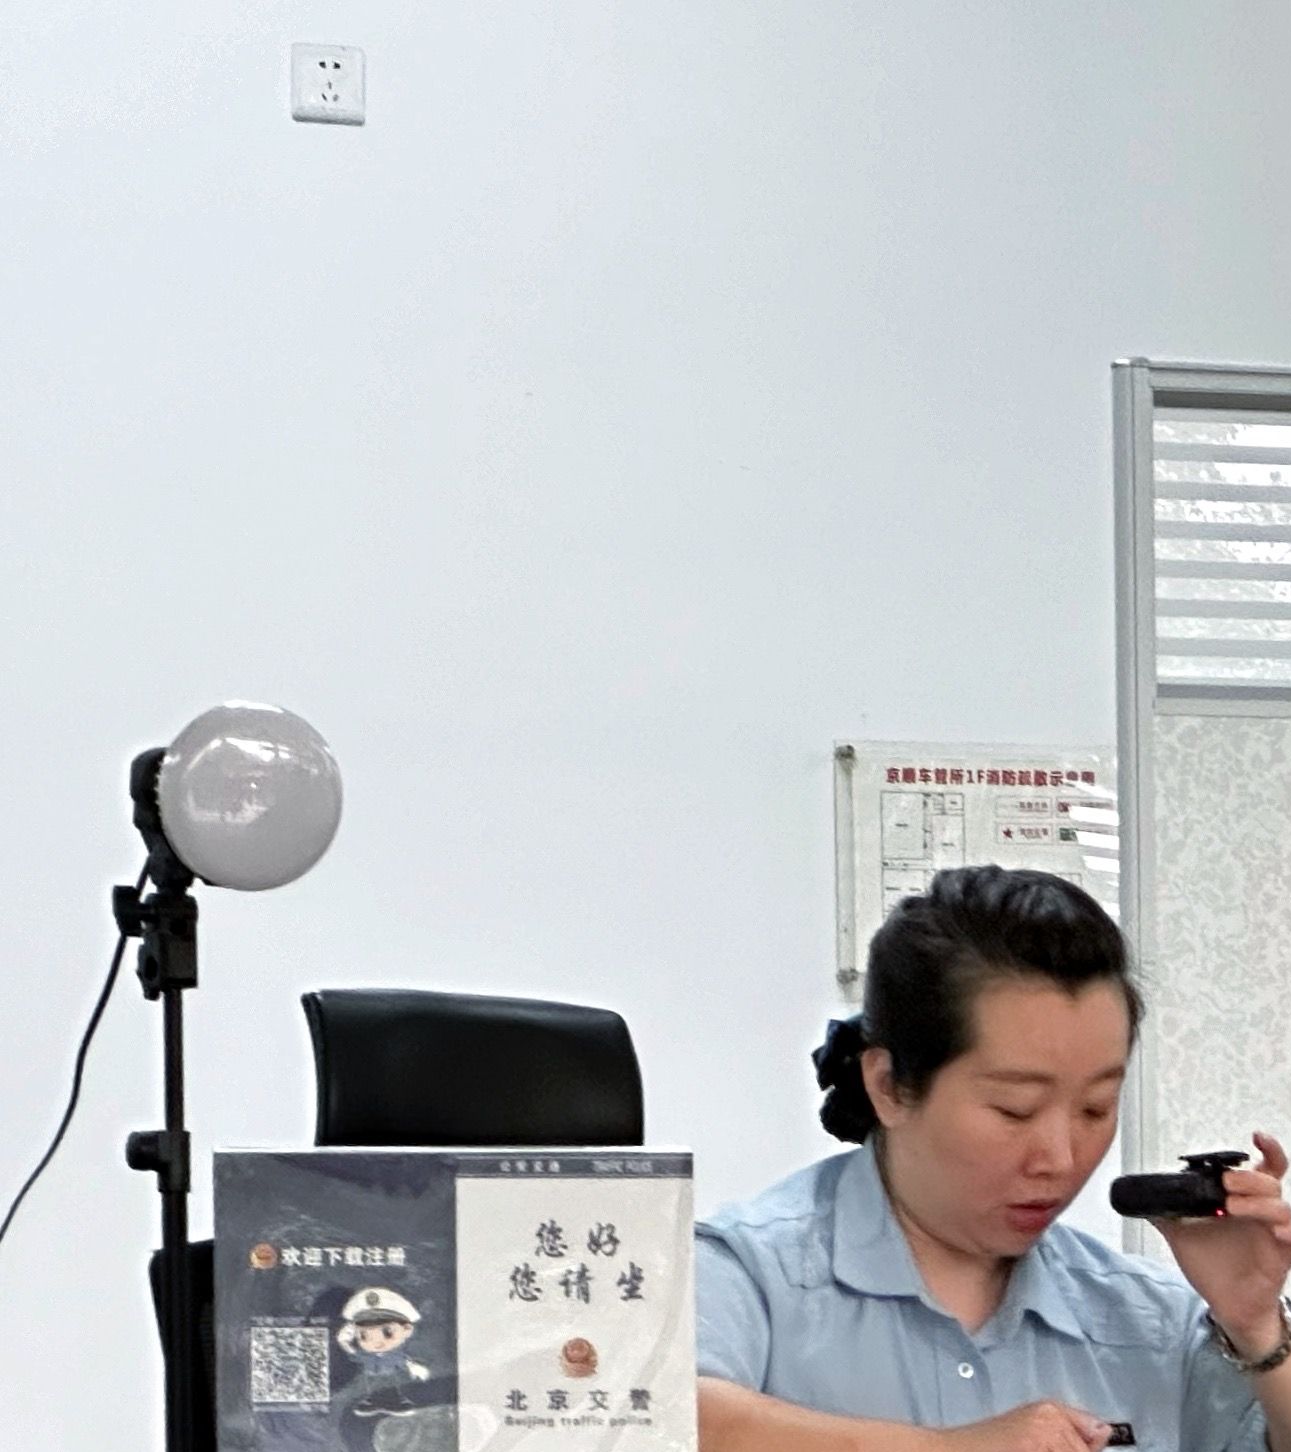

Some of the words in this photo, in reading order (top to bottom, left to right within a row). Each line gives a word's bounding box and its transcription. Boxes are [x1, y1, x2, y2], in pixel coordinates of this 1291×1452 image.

[534, 1219, 620, 1258] 您好
[281, 1245, 406, 1267] 欢迎下载注册
[509, 1261, 645, 1304] 您请坐
[505, 1388, 652, 1411] 北京交警
